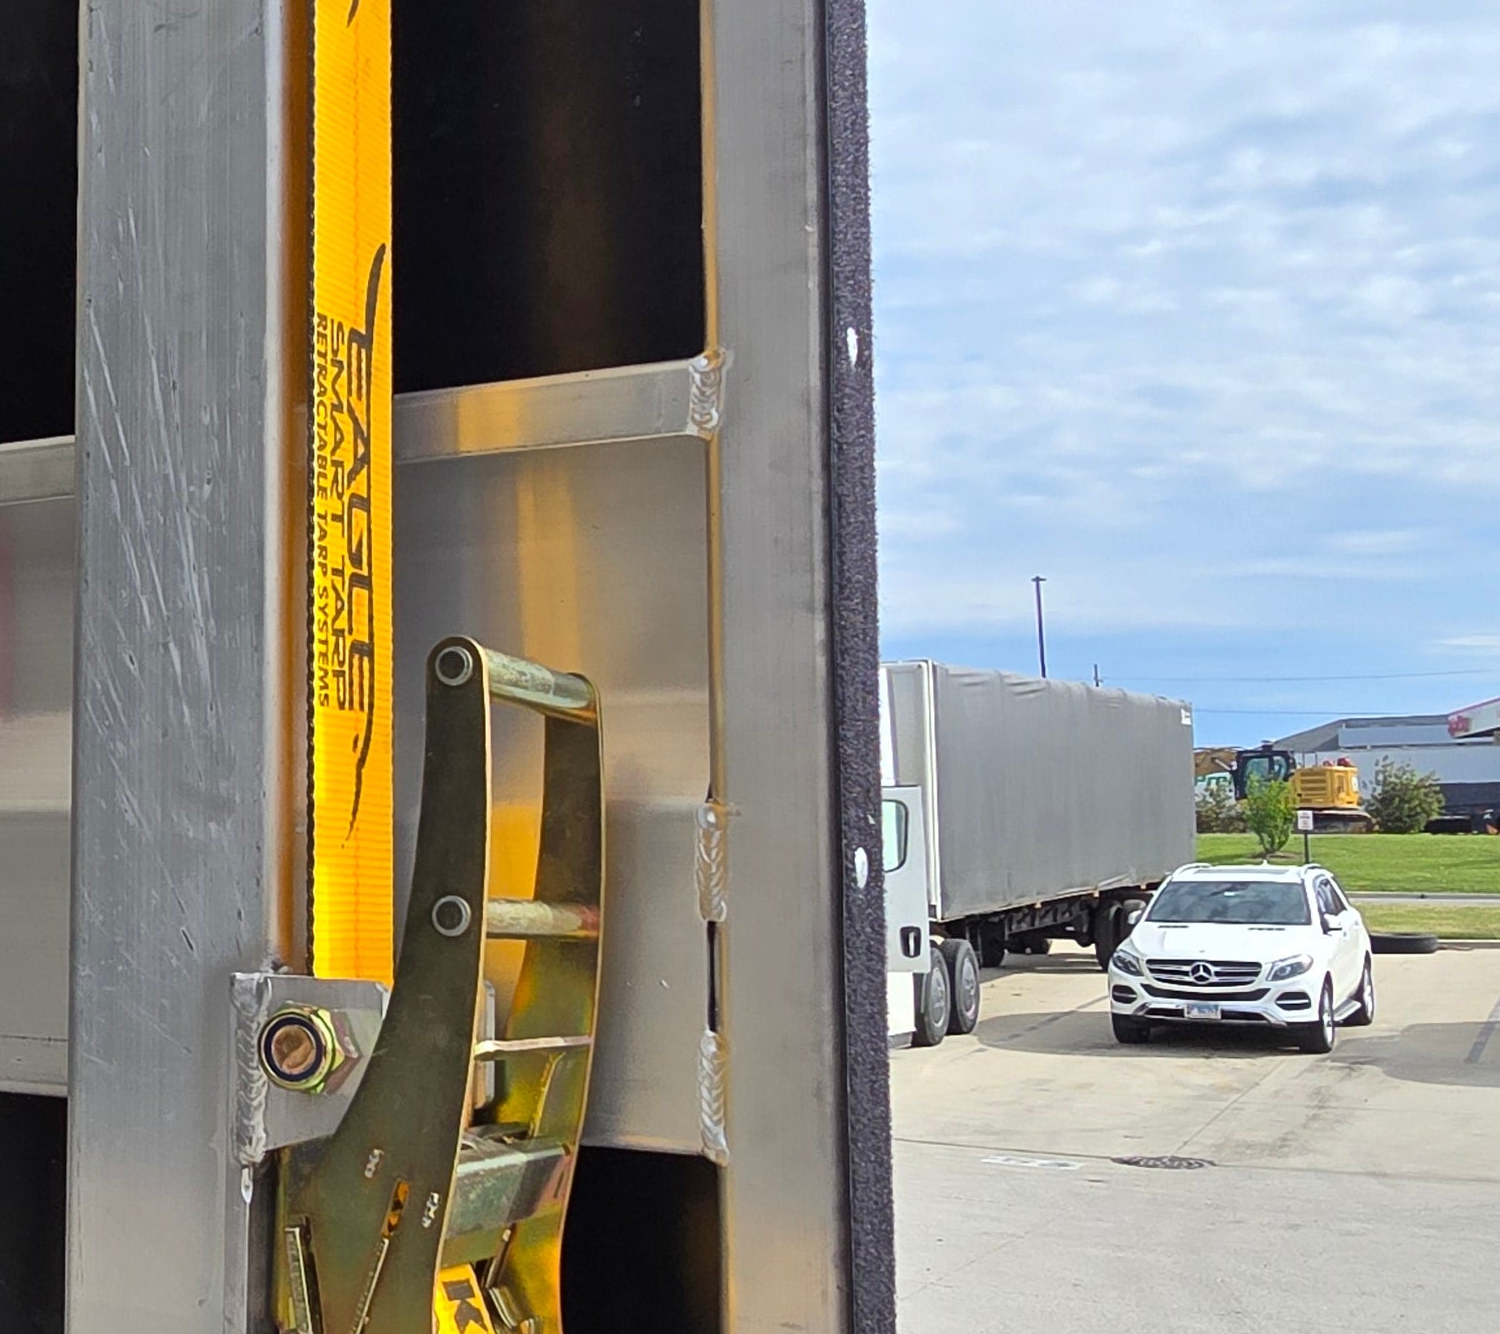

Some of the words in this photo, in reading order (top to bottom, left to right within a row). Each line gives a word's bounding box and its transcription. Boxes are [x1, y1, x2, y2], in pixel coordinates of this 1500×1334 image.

[316, 311, 329, 500] RETRACTABLE
[329, 318, 346, 540] SMART
[316, 509, 329, 578] TARP
[347, 326, 375, 713] EAGLE
[317, 585, 330, 708] SYSTEMS
[330, 554, 347, 711] TARP
